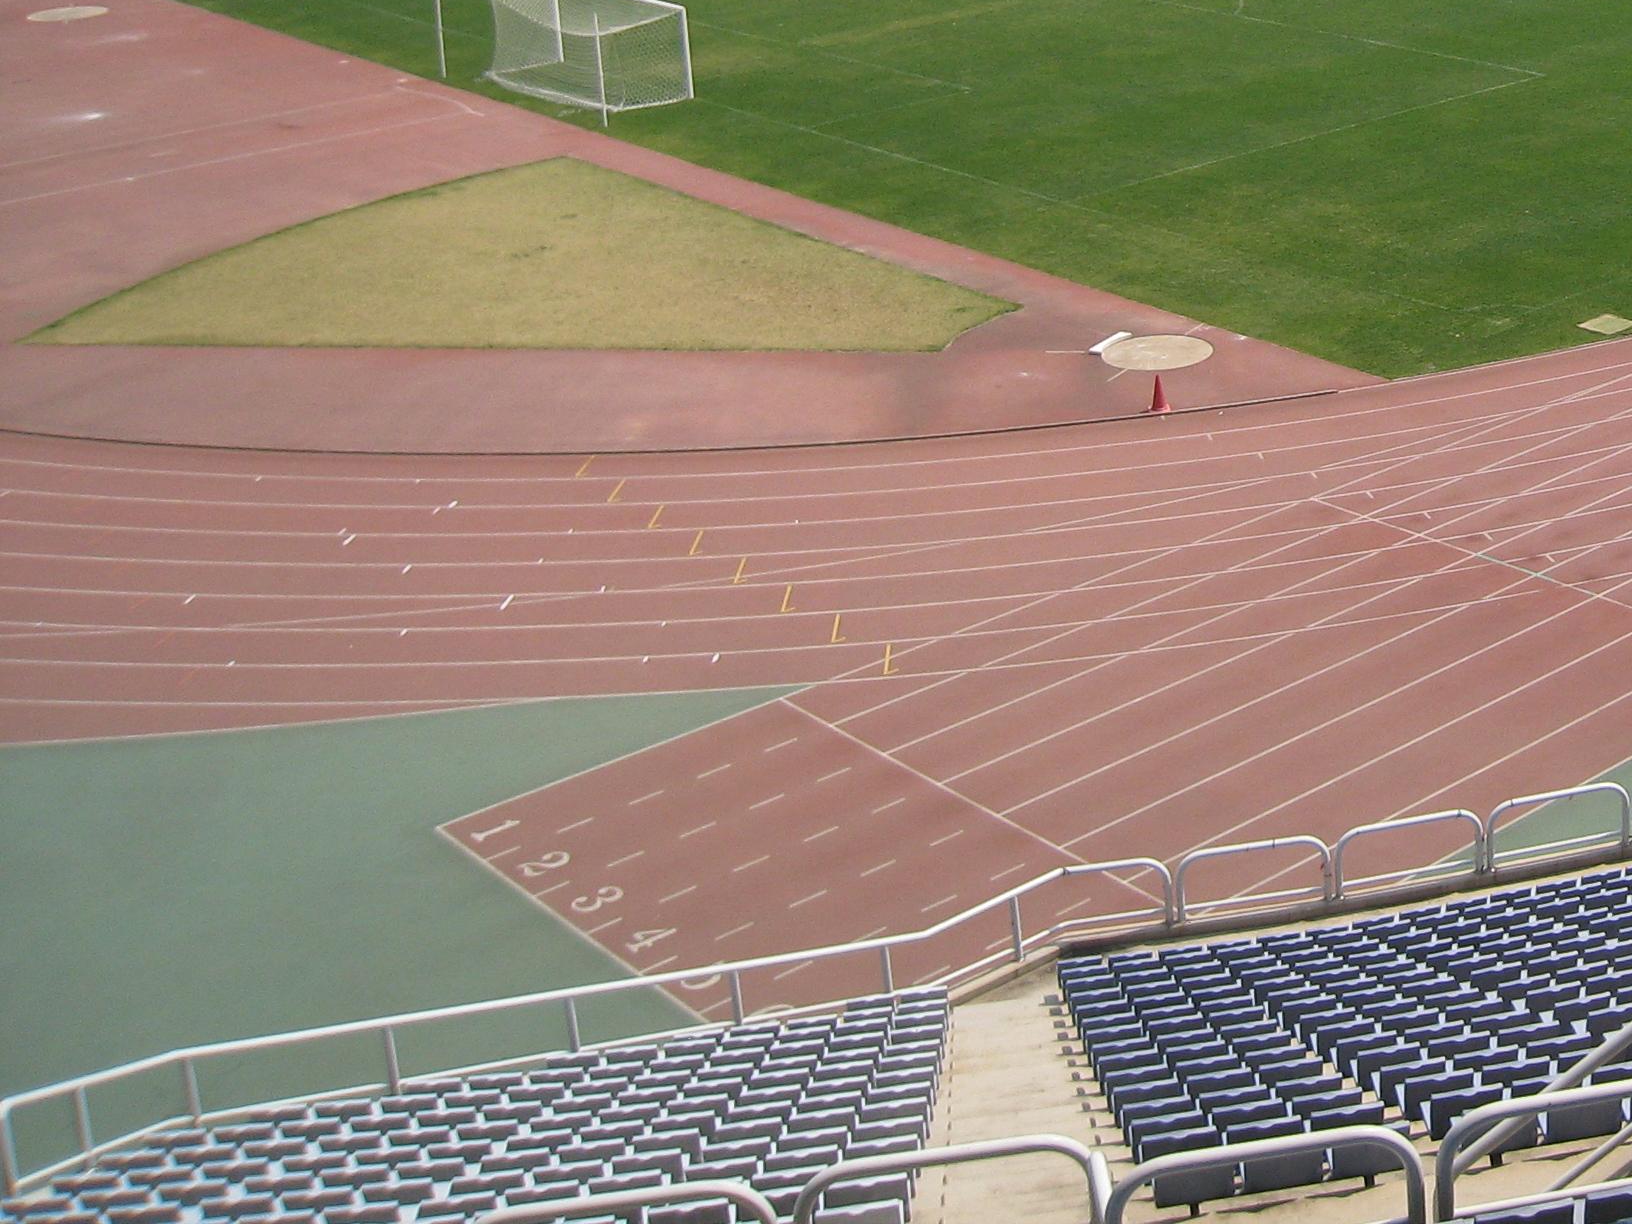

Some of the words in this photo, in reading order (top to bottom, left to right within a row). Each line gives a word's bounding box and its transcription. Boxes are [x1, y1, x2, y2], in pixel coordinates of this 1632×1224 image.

[471, 819, 520, 841] 1
[517, 851, 571, 876] 2
[571, 886, 624, 912] 3
[625, 928, 677, 953] 4
